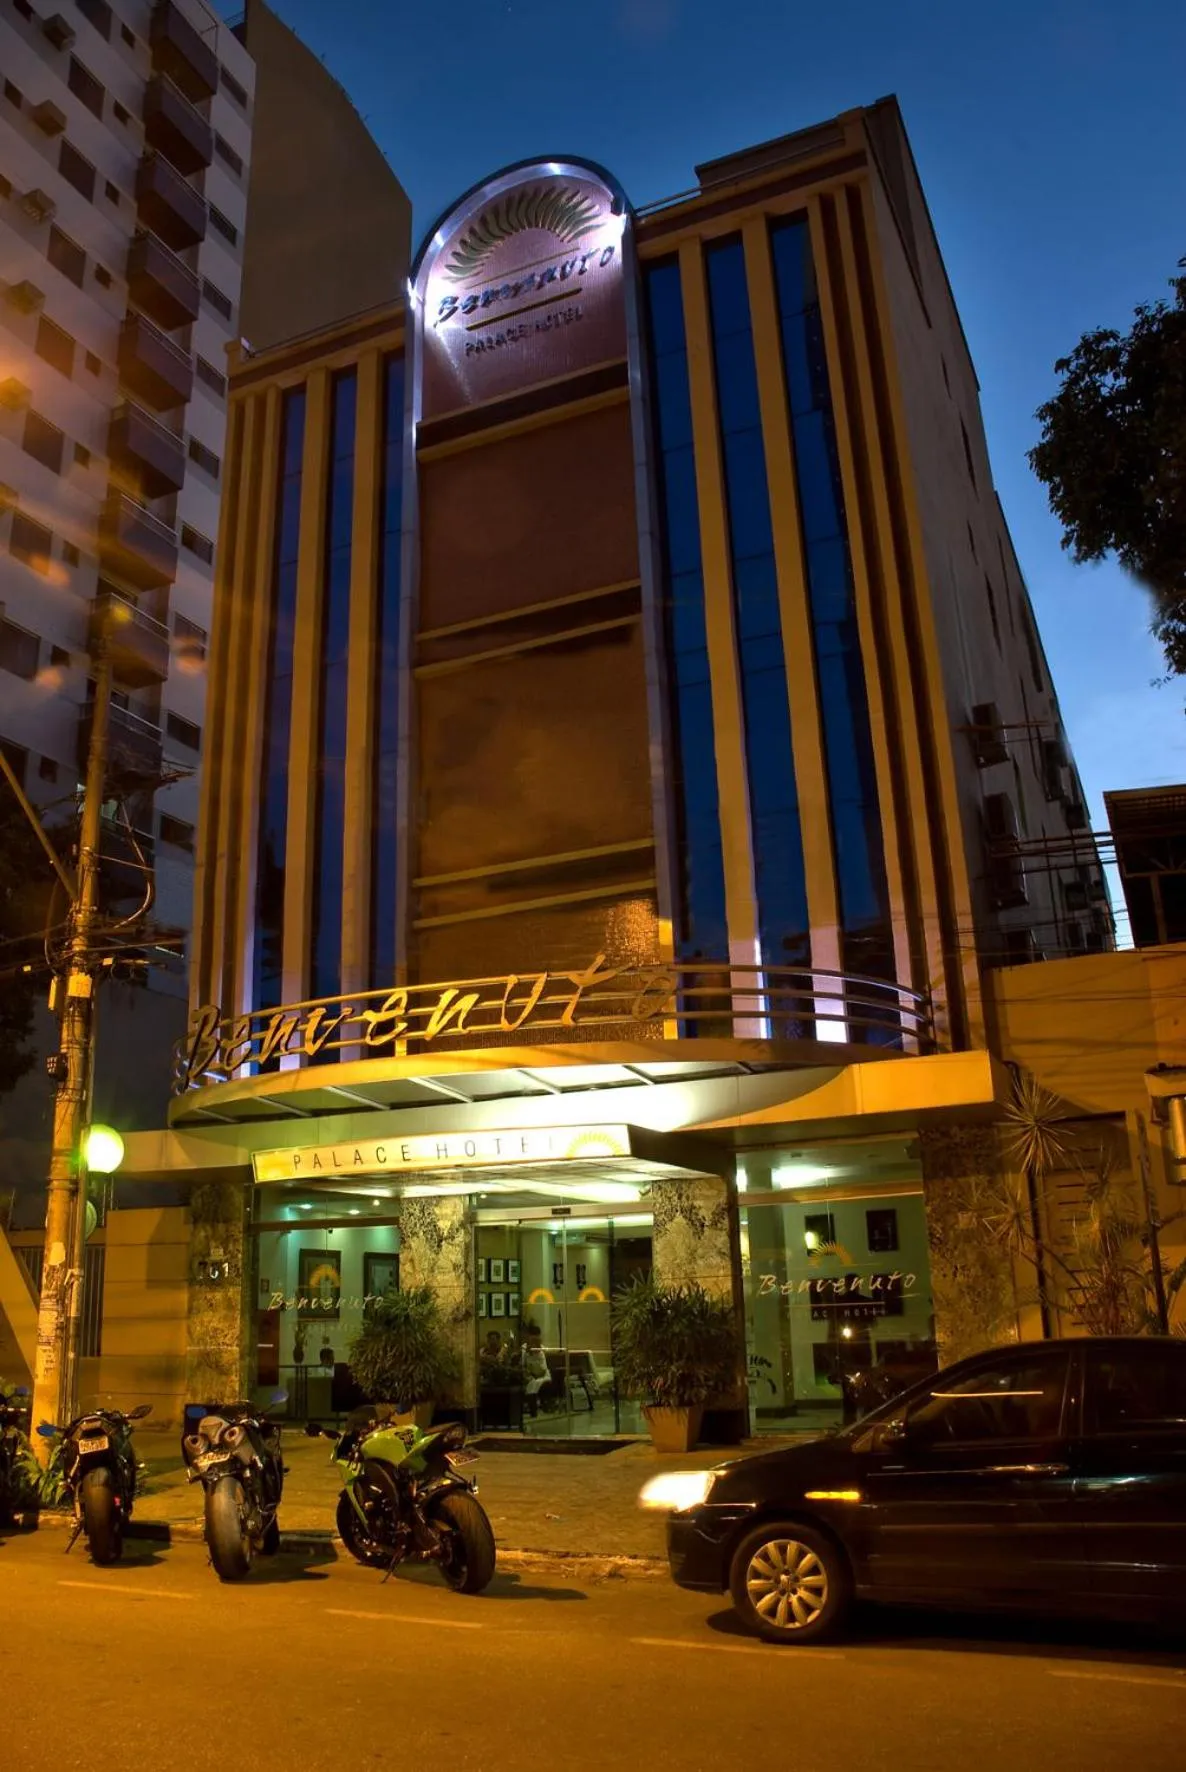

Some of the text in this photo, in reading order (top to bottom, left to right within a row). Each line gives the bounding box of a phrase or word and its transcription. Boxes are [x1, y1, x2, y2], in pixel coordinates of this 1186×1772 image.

[183, 954, 677, 1095] Benvenuto
[293, 1145, 410, 1170] PALACE
[758, 1270, 917, 1296] Benvenuto
